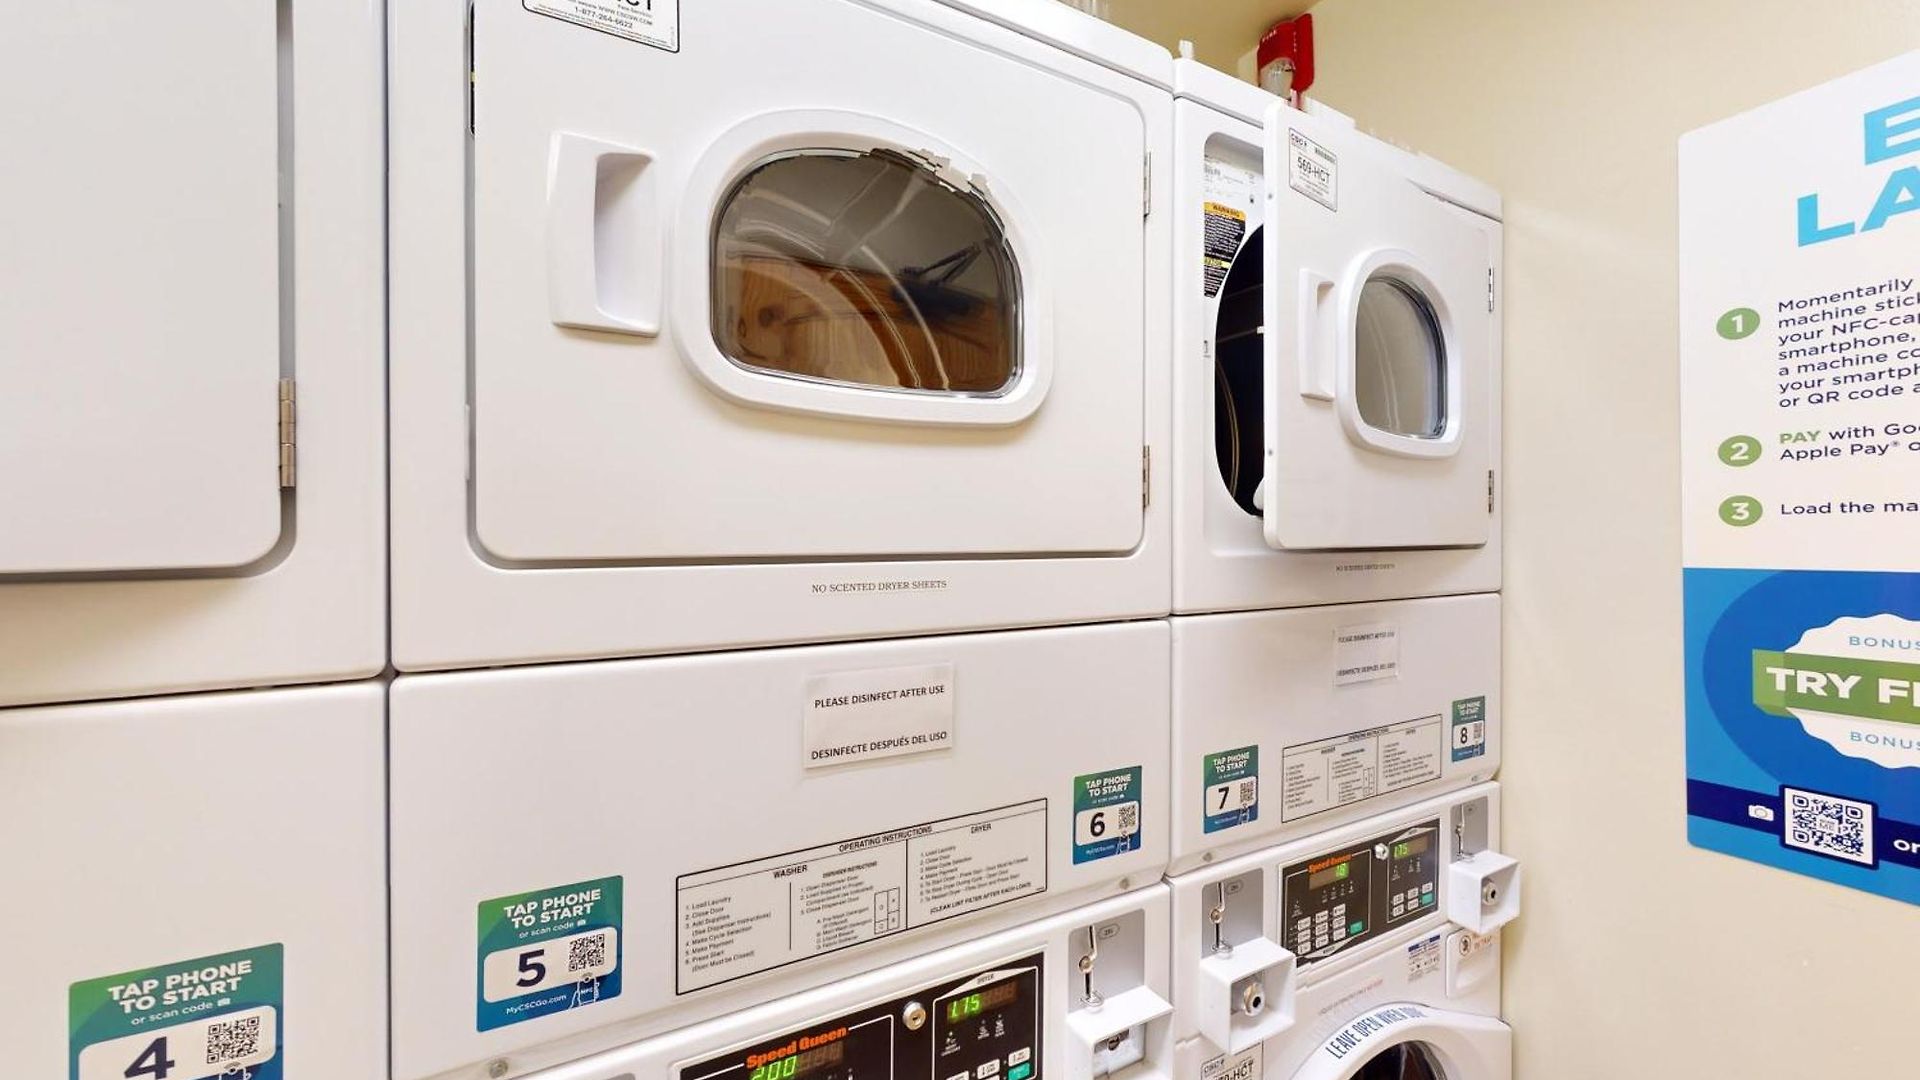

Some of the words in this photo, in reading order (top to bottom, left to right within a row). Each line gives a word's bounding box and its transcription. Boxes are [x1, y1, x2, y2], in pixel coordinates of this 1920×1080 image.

[1778, 278, 1914, 313] Momentarily
[1732, 315, 1743, 333] 1
[1778, 305, 1867, 329] machine
[1778, 329, 1824, 346] your
[1832, 313, 1920, 336] NFC-ca
[1778, 367, 1789, 376] a
[1797, 352, 1888, 374] machine
[1778, 377, 1824, 394] your
[1779, 397, 1800, 408] or
[1808, 391, 1839, 405] QR
[1848, 385, 1904, 400] code
[1779, 431, 1820, 444] PAY
[1829, 426, 1875, 440] with
[1730, 442, 1749, 460] 2
[1781, 446, 1841, 461] Apple
[1731, 503, 1749, 520] 3
[1781, 503, 1831, 515] Load
[1840, 502, 1874, 513] the
[812, 584, 826, 593] NO
[829, 582, 876, 592] SCENTED
[878, 581, 909, 591] DRYER
[912, 580, 947, 589] SHEETS
[814, 695, 849, 709] PLEASE
[852, 690, 898, 705] DISINFECT
[900, 687, 926, 699] AFTER
[929, 685, 945, 694] USE
[1766, 667, 1863, 698] TRY
[1878, 679, 1920, 707] F
[811, 743, 868, 760] DESINFECTE
[870, 737, 910, 752] DESPUÉS
[911, 734, 927, 745] DEL
[929, 731, 947, 742] USO
[1461, 727, 1468, 744] 8
[1226, 760, 1248, 771] START
[1086, 780, 1102, 790] TAP
[1103, 773, 1132, 786] PHONE
[1088, 789, 1101, 797] TO
[1102, 783, 1128, 796] START
[1218, 786, 1229, 810] 7
[971, 823, 992, 834] DRYER
[1090, 812, 1106, 837] 6
[839, 838, 881, 852] OPERATING
[881, 826, 933, 842] INSTRUCTIONS
[773, 864, 808, 879] WASHER
[504, 901, 538, 919] TAP
[543, 889, 601, 908] PHONE
[512, 916, 536, 929] TO
[541, 903, 594, 924] START
[530, 927, 550, 936] scan
[553, 921, 574, 932] code
[107, 979, 159, 1001] TAP
[166, 960, 253, 990] PHONE
[516, 949, 546, 988] 5
[119, 997, 156, 1014] TO
[162, 977, 243, 1006] START
[506, 994, 567, 1015] MyCSCGo.com
[131, 1016, 146, 1026] or
[148, 1009, 179, 1022] scan
[182, 1002, 214, 1015] code
[747, 1041, 797, 1069] Speed
[800, 1027, 847, 1051] Queen
[1325, 1029, 1362, 1059] LEAVE
[1351, 1016, 1383, 1038] OPEN
[124, 1036, 175, 1080] 4
